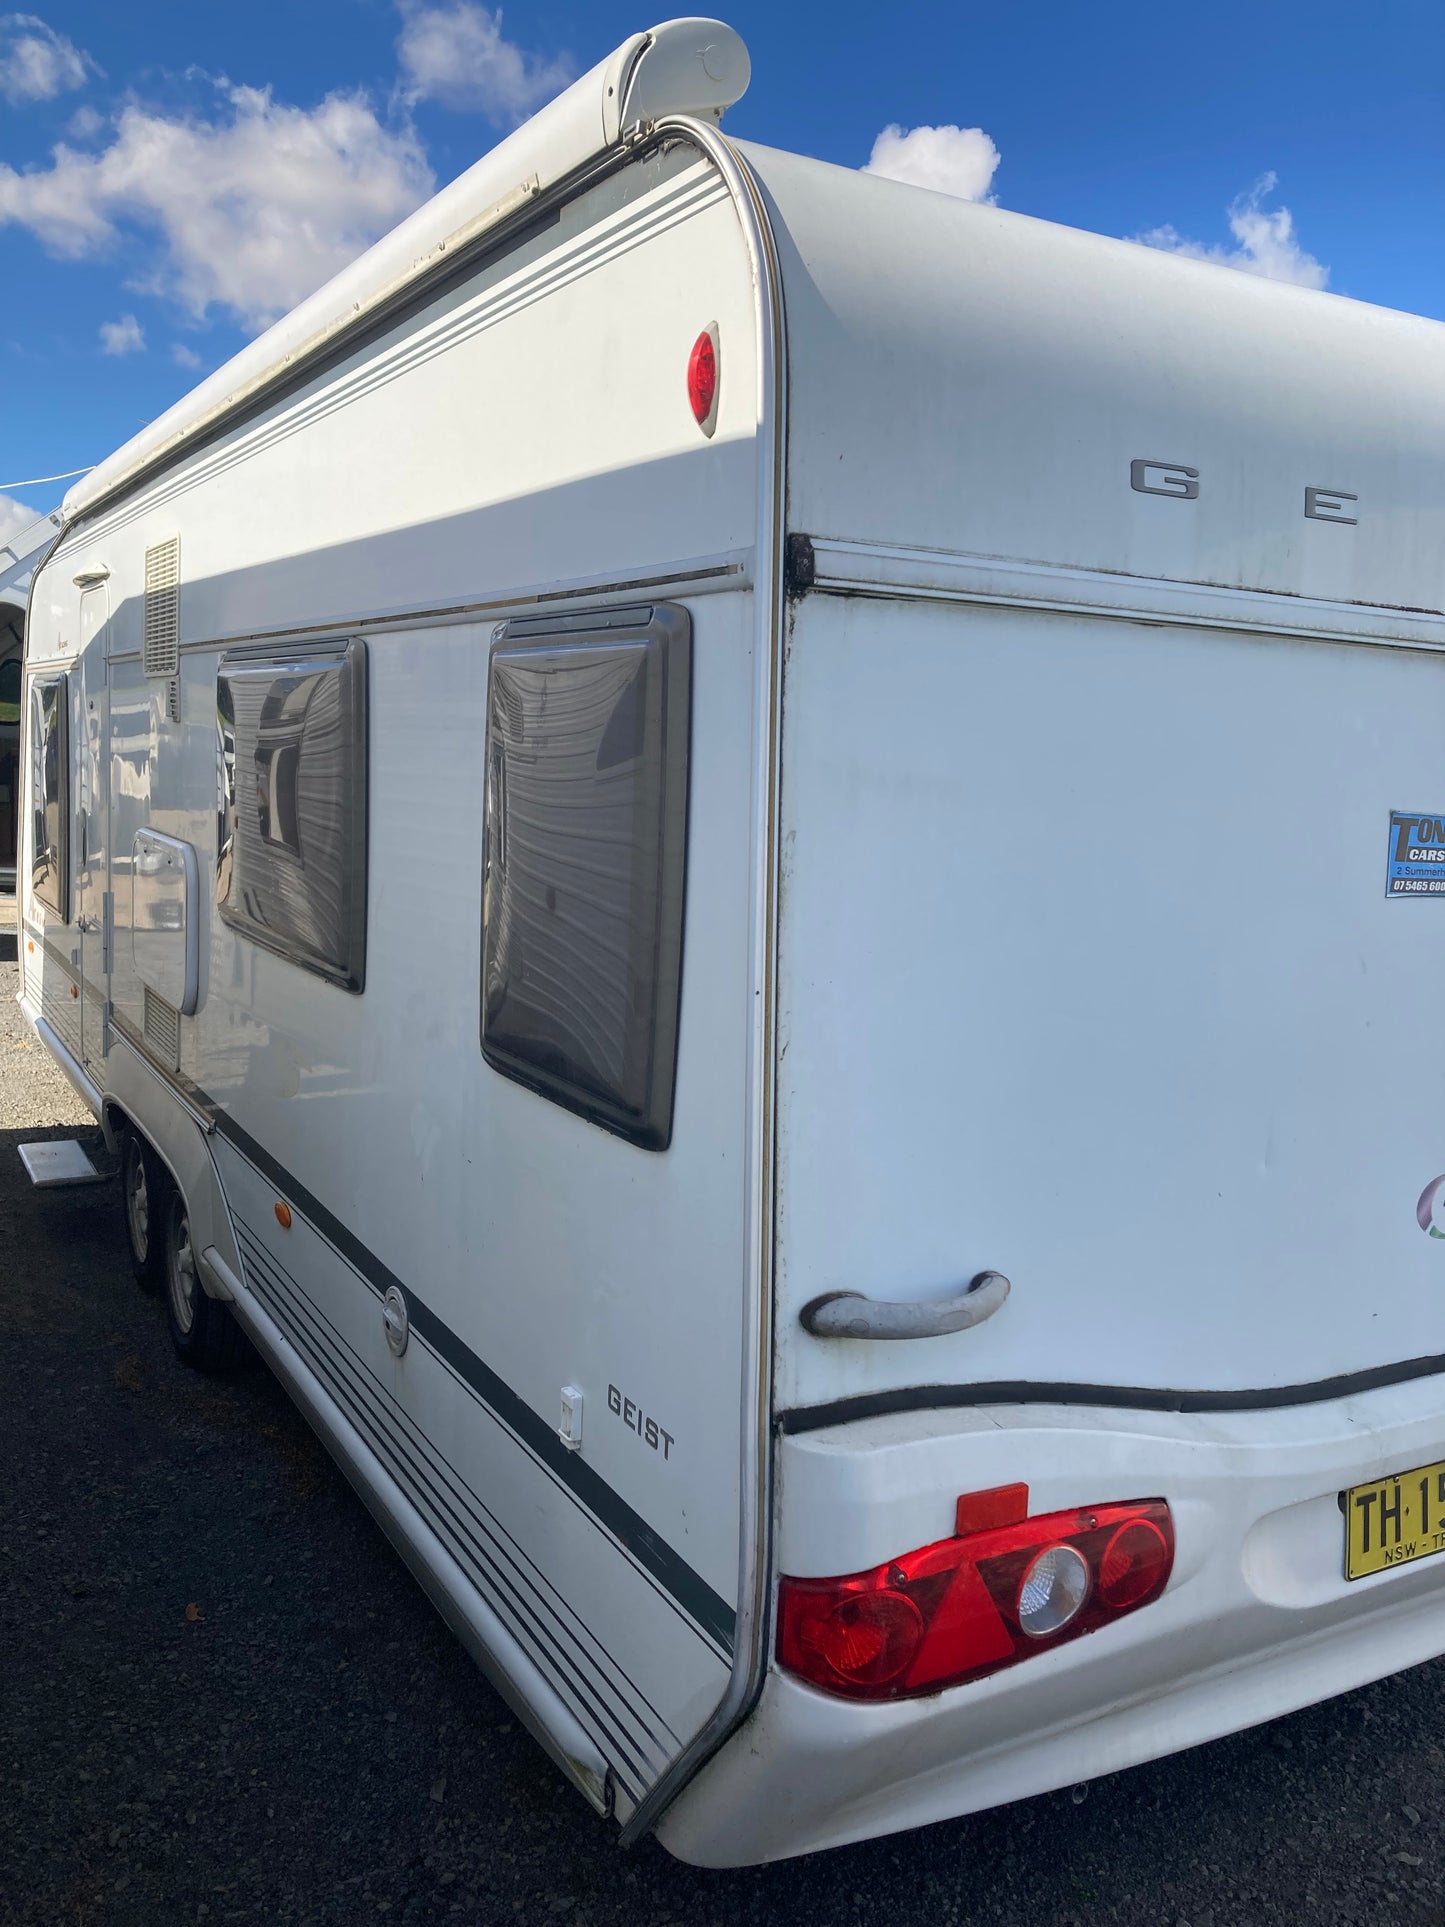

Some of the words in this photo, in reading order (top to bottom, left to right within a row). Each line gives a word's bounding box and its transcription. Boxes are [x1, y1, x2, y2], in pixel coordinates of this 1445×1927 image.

[1409, 848, 1445, 861] CARS
[1397, 866, 1402, 875] 2
[1394, 881, 1404, 890] 07
[1405, 881, 1428, 891] 5465
[608, 1384, 674, 1461] GEIST
[1385, 1542, 1416, 1564] NSW
